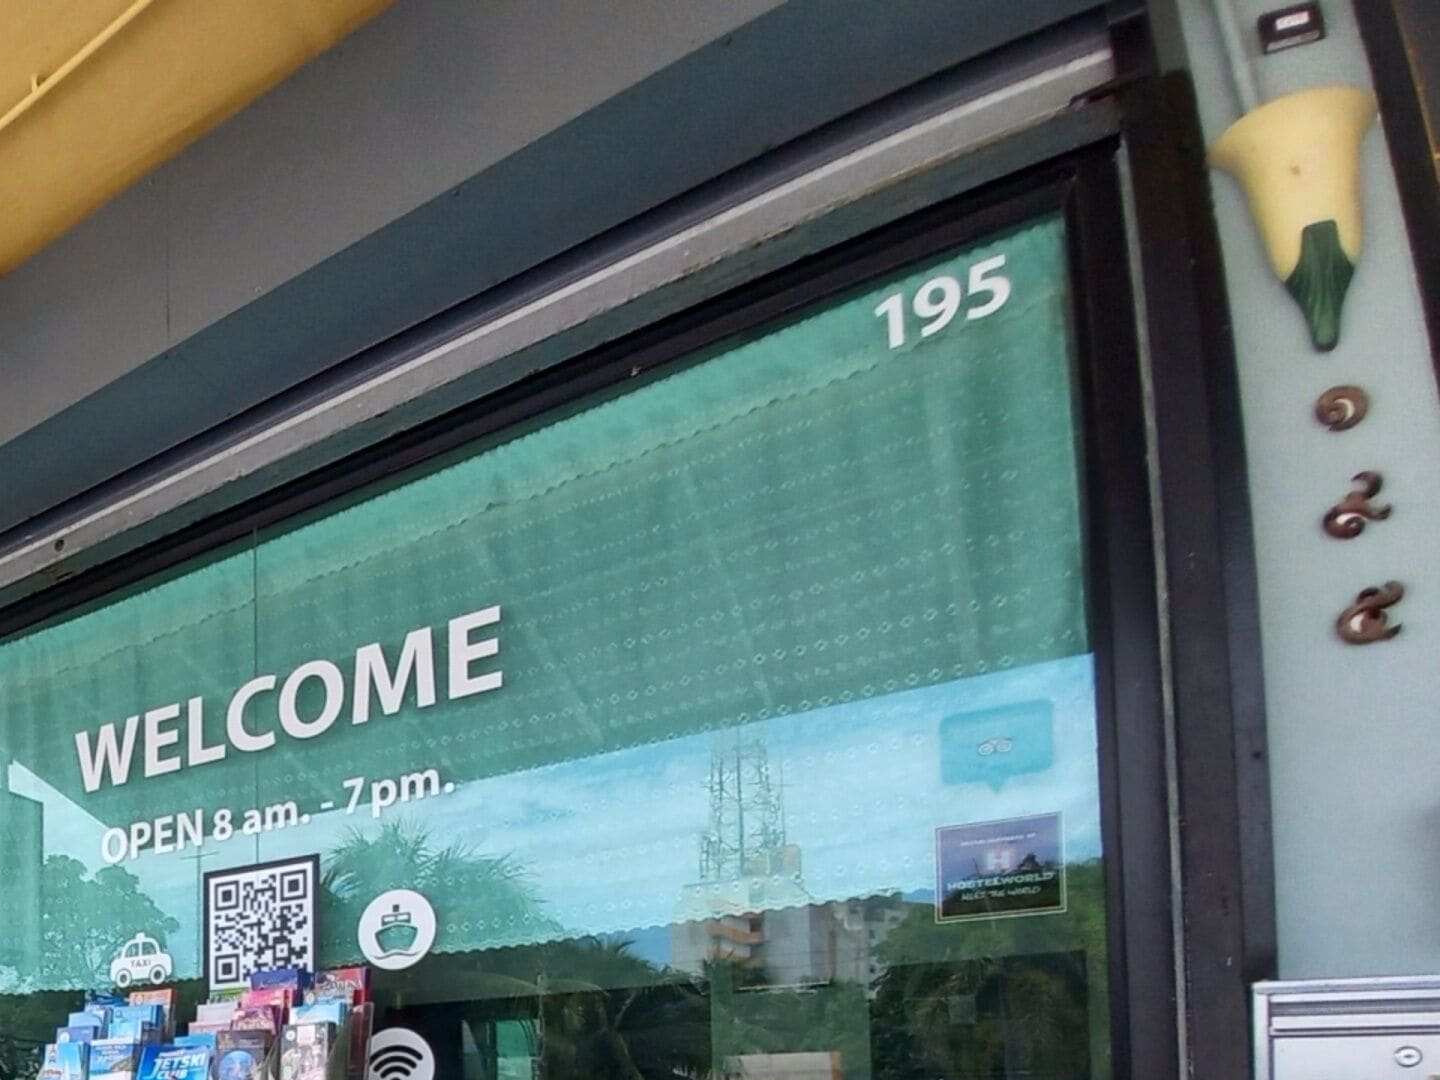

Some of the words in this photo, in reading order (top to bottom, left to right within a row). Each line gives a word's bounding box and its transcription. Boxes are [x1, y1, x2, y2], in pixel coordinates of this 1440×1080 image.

[873, 254, 1011, 350] 195
[75, 605, 502, 793] WELCOME
[101, 809, 203, 864] OPEN
[213, 808, 232, 842] 8
[242, 799, 311, 836] am.
[342, 777, 365, 816] 7
[371, 767, 456, 819] pm.
[130, 959, 152, 968] TAXI
